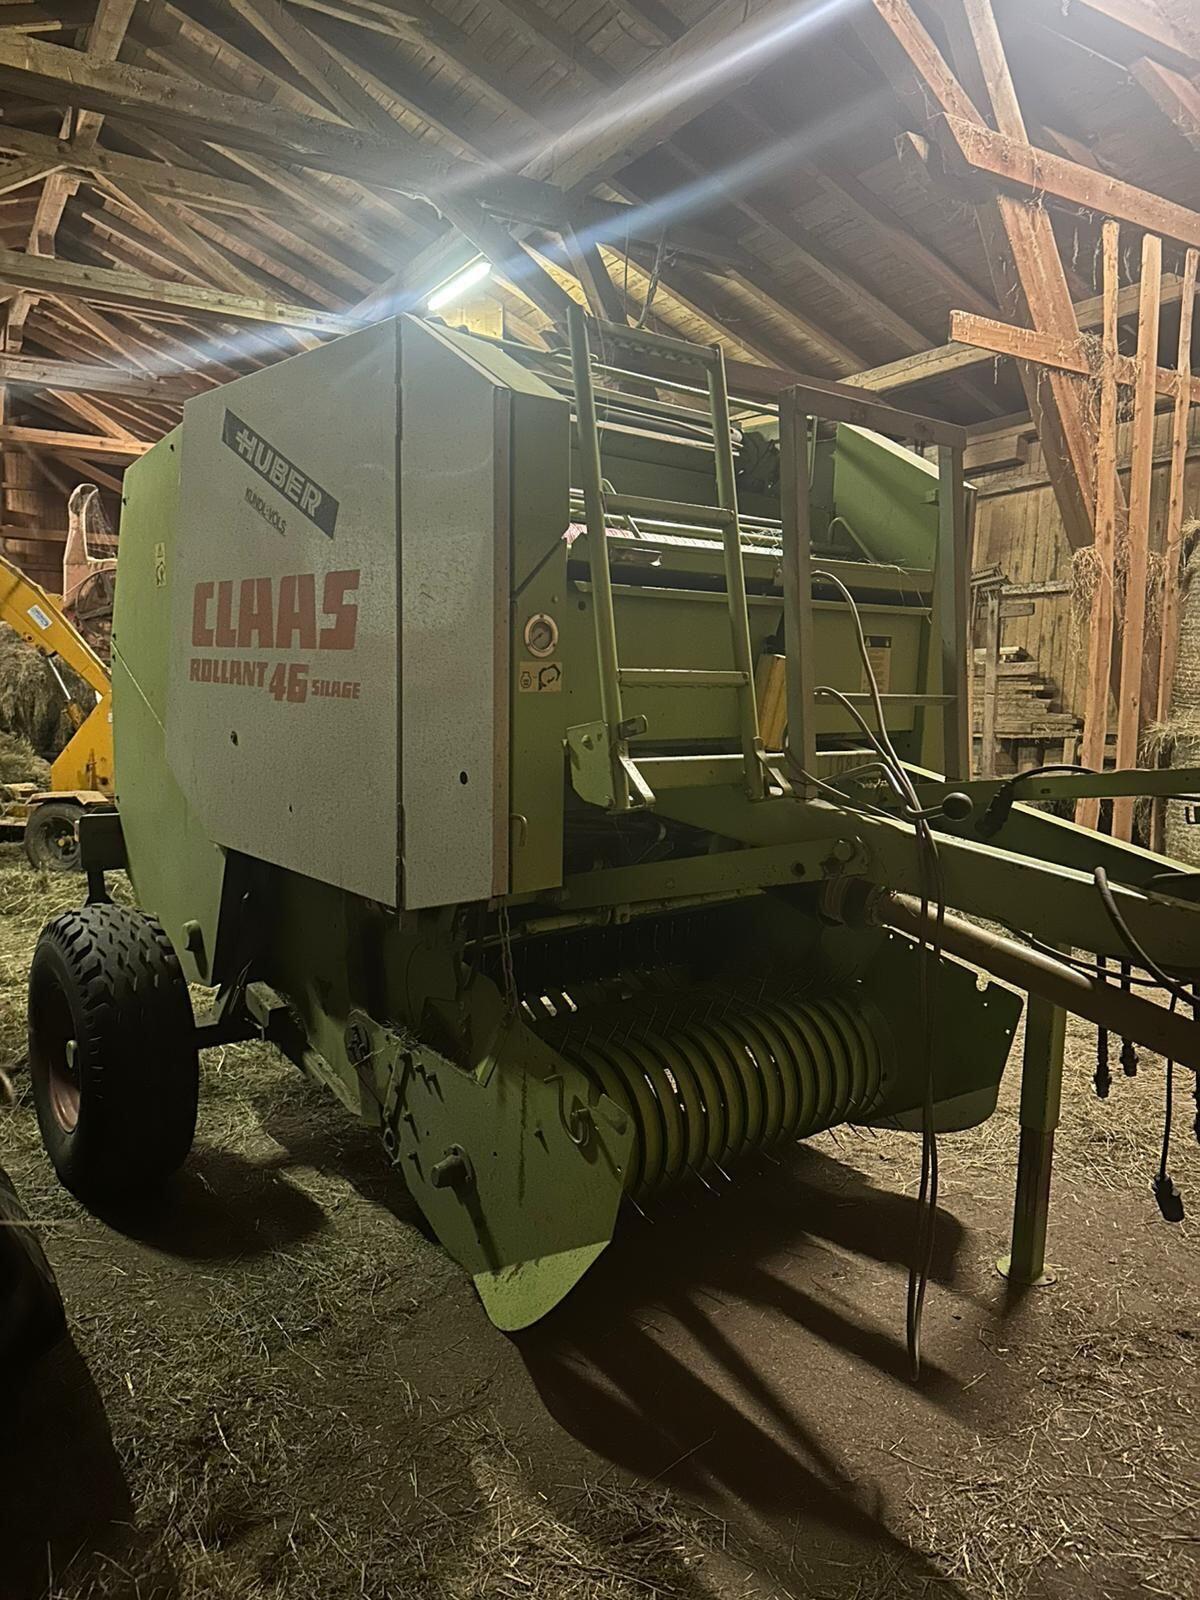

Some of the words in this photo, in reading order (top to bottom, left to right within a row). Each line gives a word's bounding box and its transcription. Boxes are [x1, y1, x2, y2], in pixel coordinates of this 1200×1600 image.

[235, 429, 322, 518] HUBER
[192, 569, 360, 650] CLAAS
[189, 658, 269, 687] ROLLANT
[269, 662, 309, 704] 46
[311, 679, 361, 699] SILAGE
